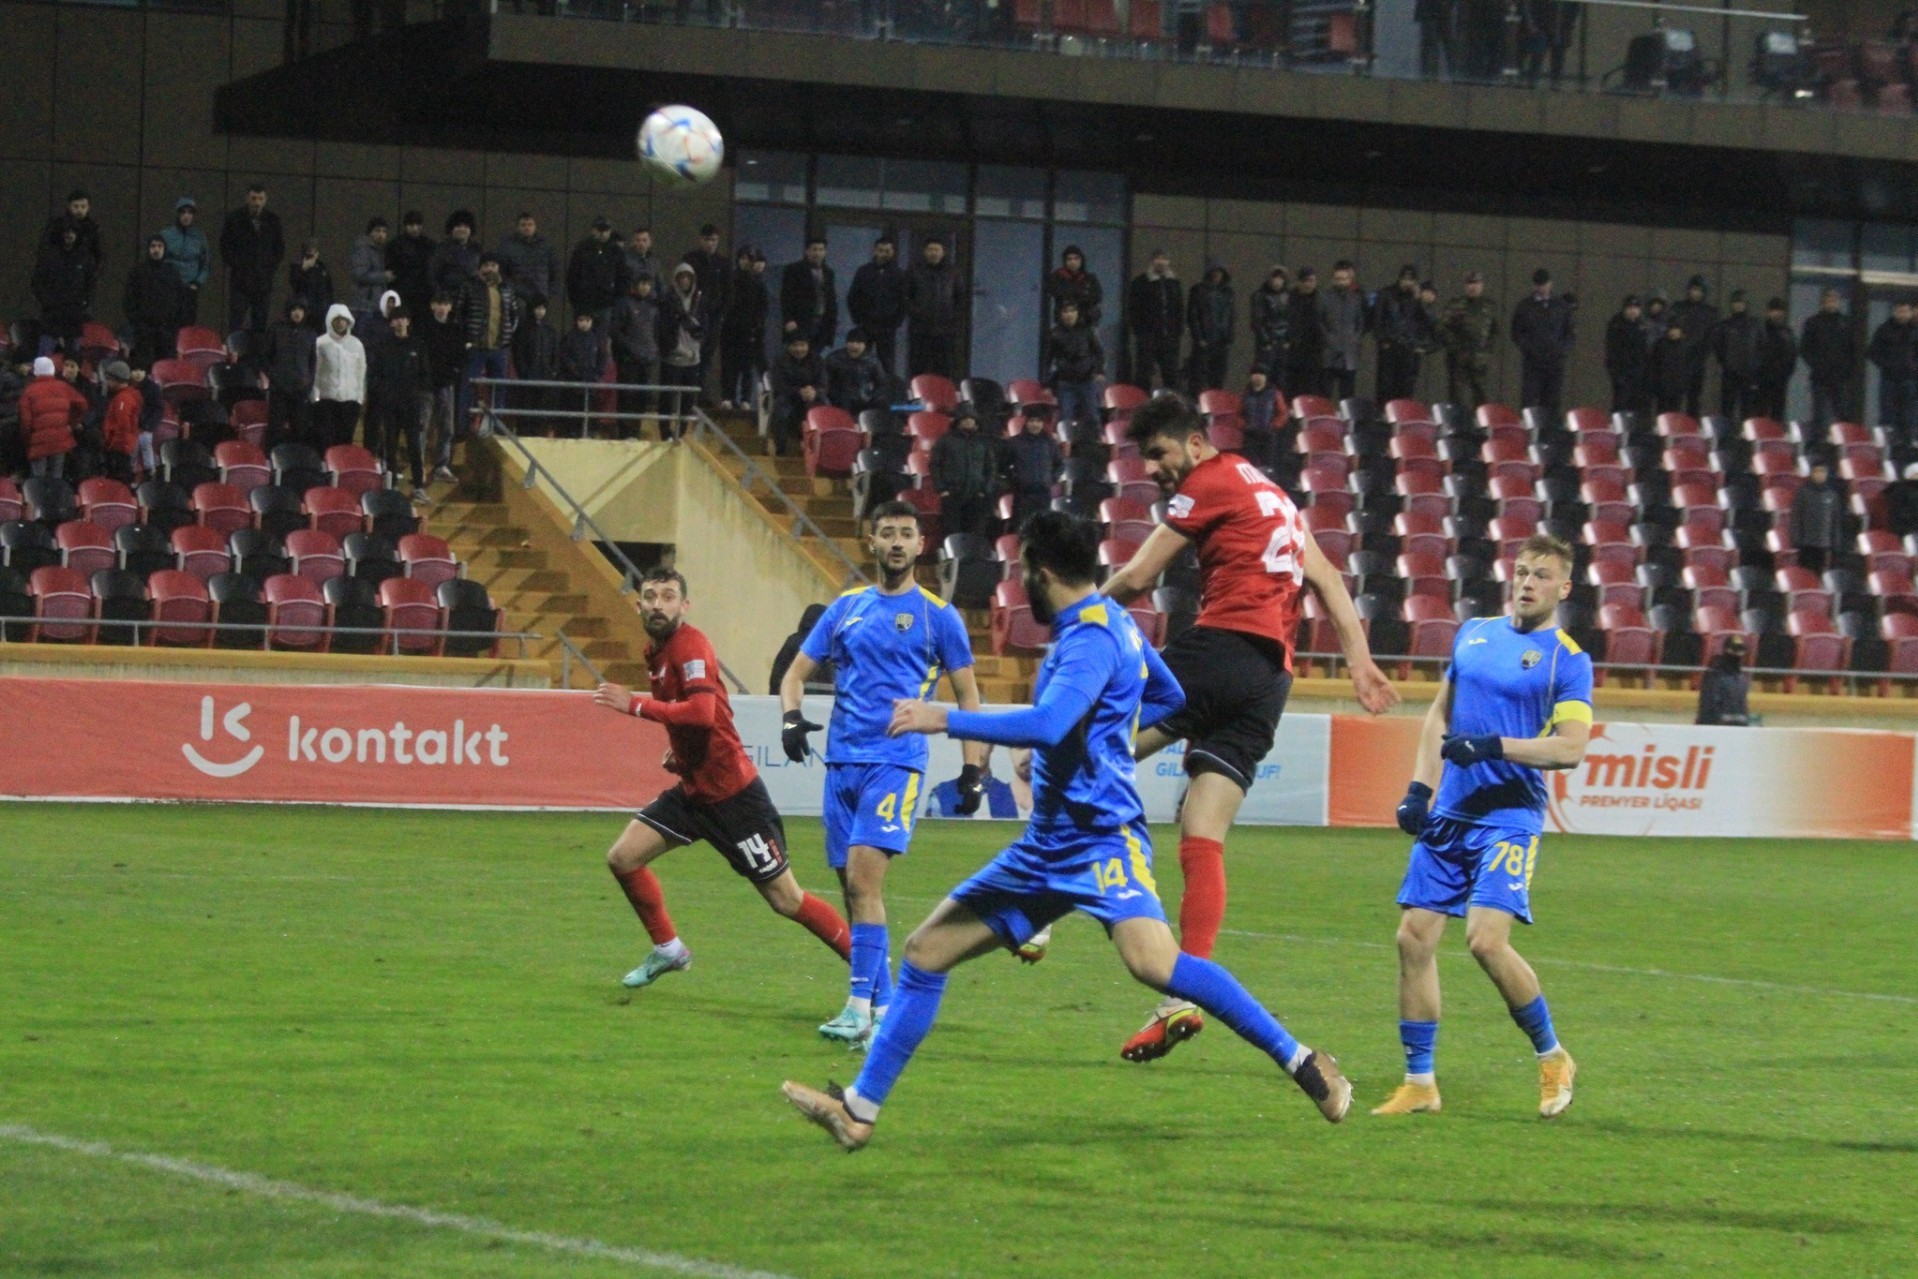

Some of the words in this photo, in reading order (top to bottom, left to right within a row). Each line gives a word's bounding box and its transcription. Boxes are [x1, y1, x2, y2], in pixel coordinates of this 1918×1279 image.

[288, 715, 509, 766] kontakt
[1156, 762, 1186, 777] GIL
[1584, 744, 1715, 789] misli
[876, 792, 896, 822] 4
[1579, 795, 1650, 808] PREMYER
[736, 833, 772, 869] 14
[1488, 841, 1524, 876] 78
[1091, 857, 1128, 896] 14
